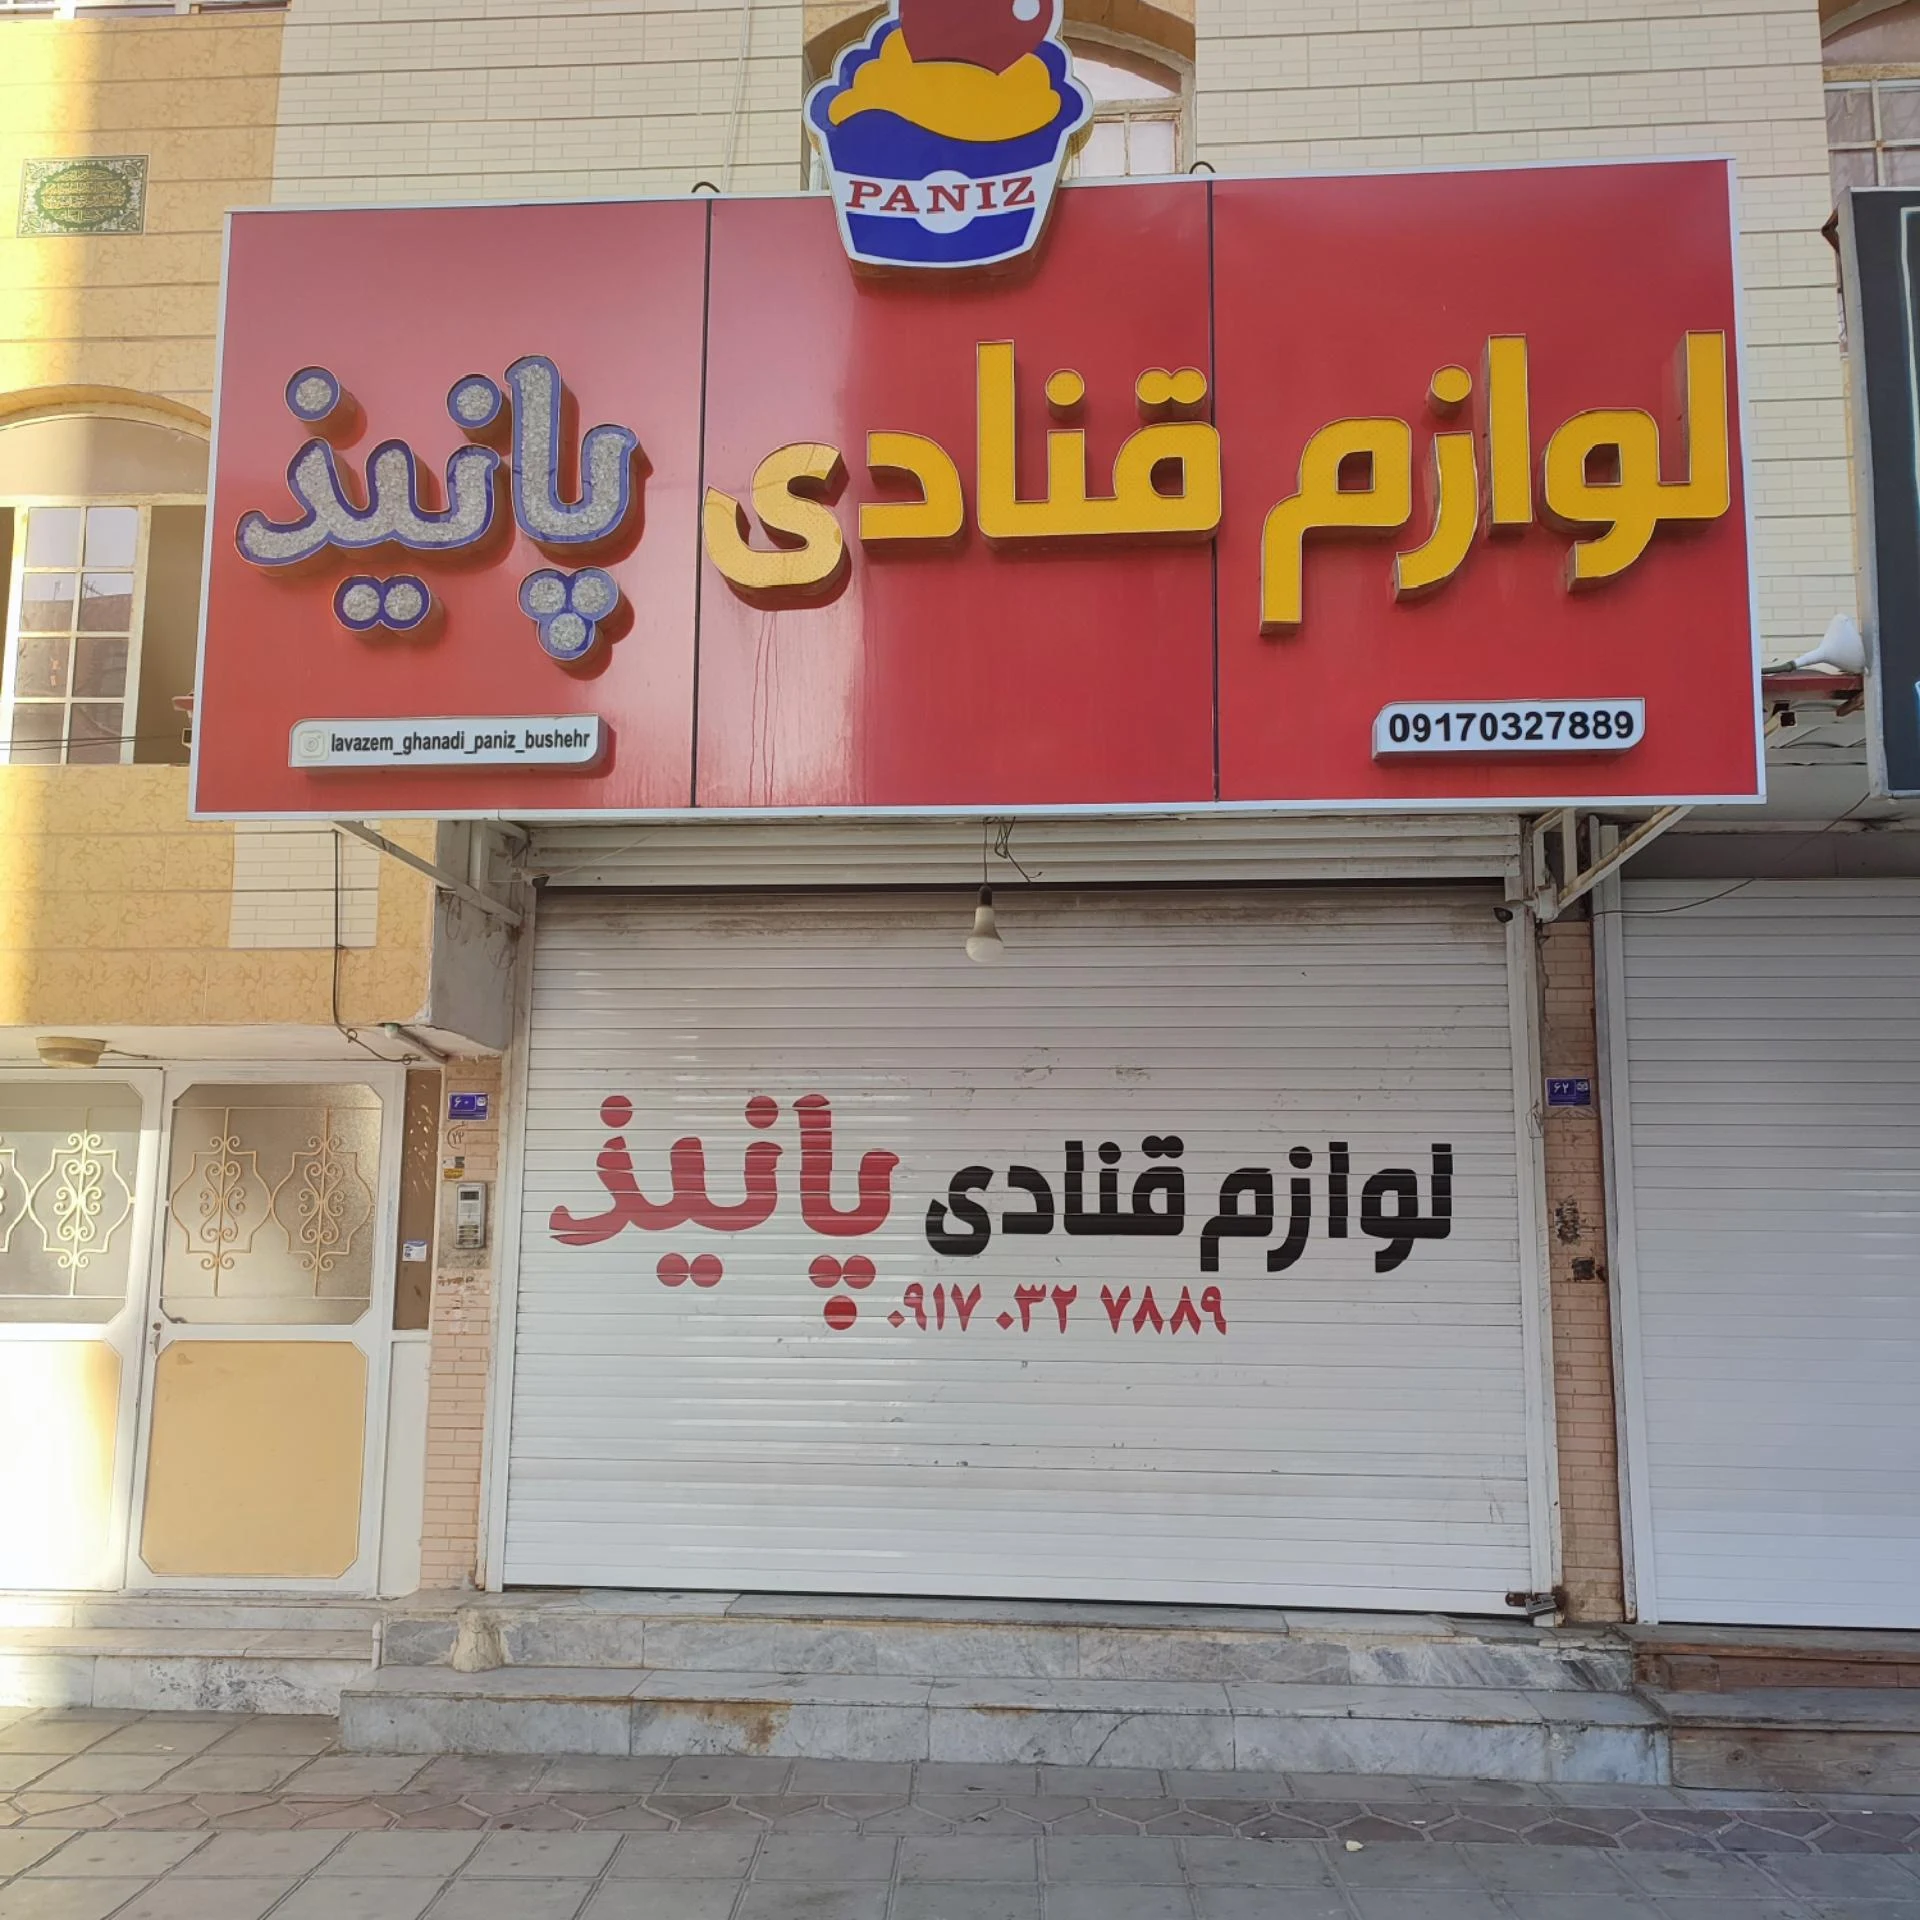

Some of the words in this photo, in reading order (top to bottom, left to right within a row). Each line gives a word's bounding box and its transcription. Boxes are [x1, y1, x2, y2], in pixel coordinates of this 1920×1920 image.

[845, 176, 1035, 214] PANIZ
[235, 354, 639, 660] پانیز
[702, 339, 1222, 588] قنادی
[1260, 330, 1731, 625] لوازم
[330, 729, 591, 757] lavazem_ghanadi_paniz_bushehr
[1388, 710, 1635, 743] 09170327889
[549, 1094, 899, 1331] پانیز
[925, 1134, 1185, 1257] قنادی
[1200, 1141, 1454, 1273] لوازم
